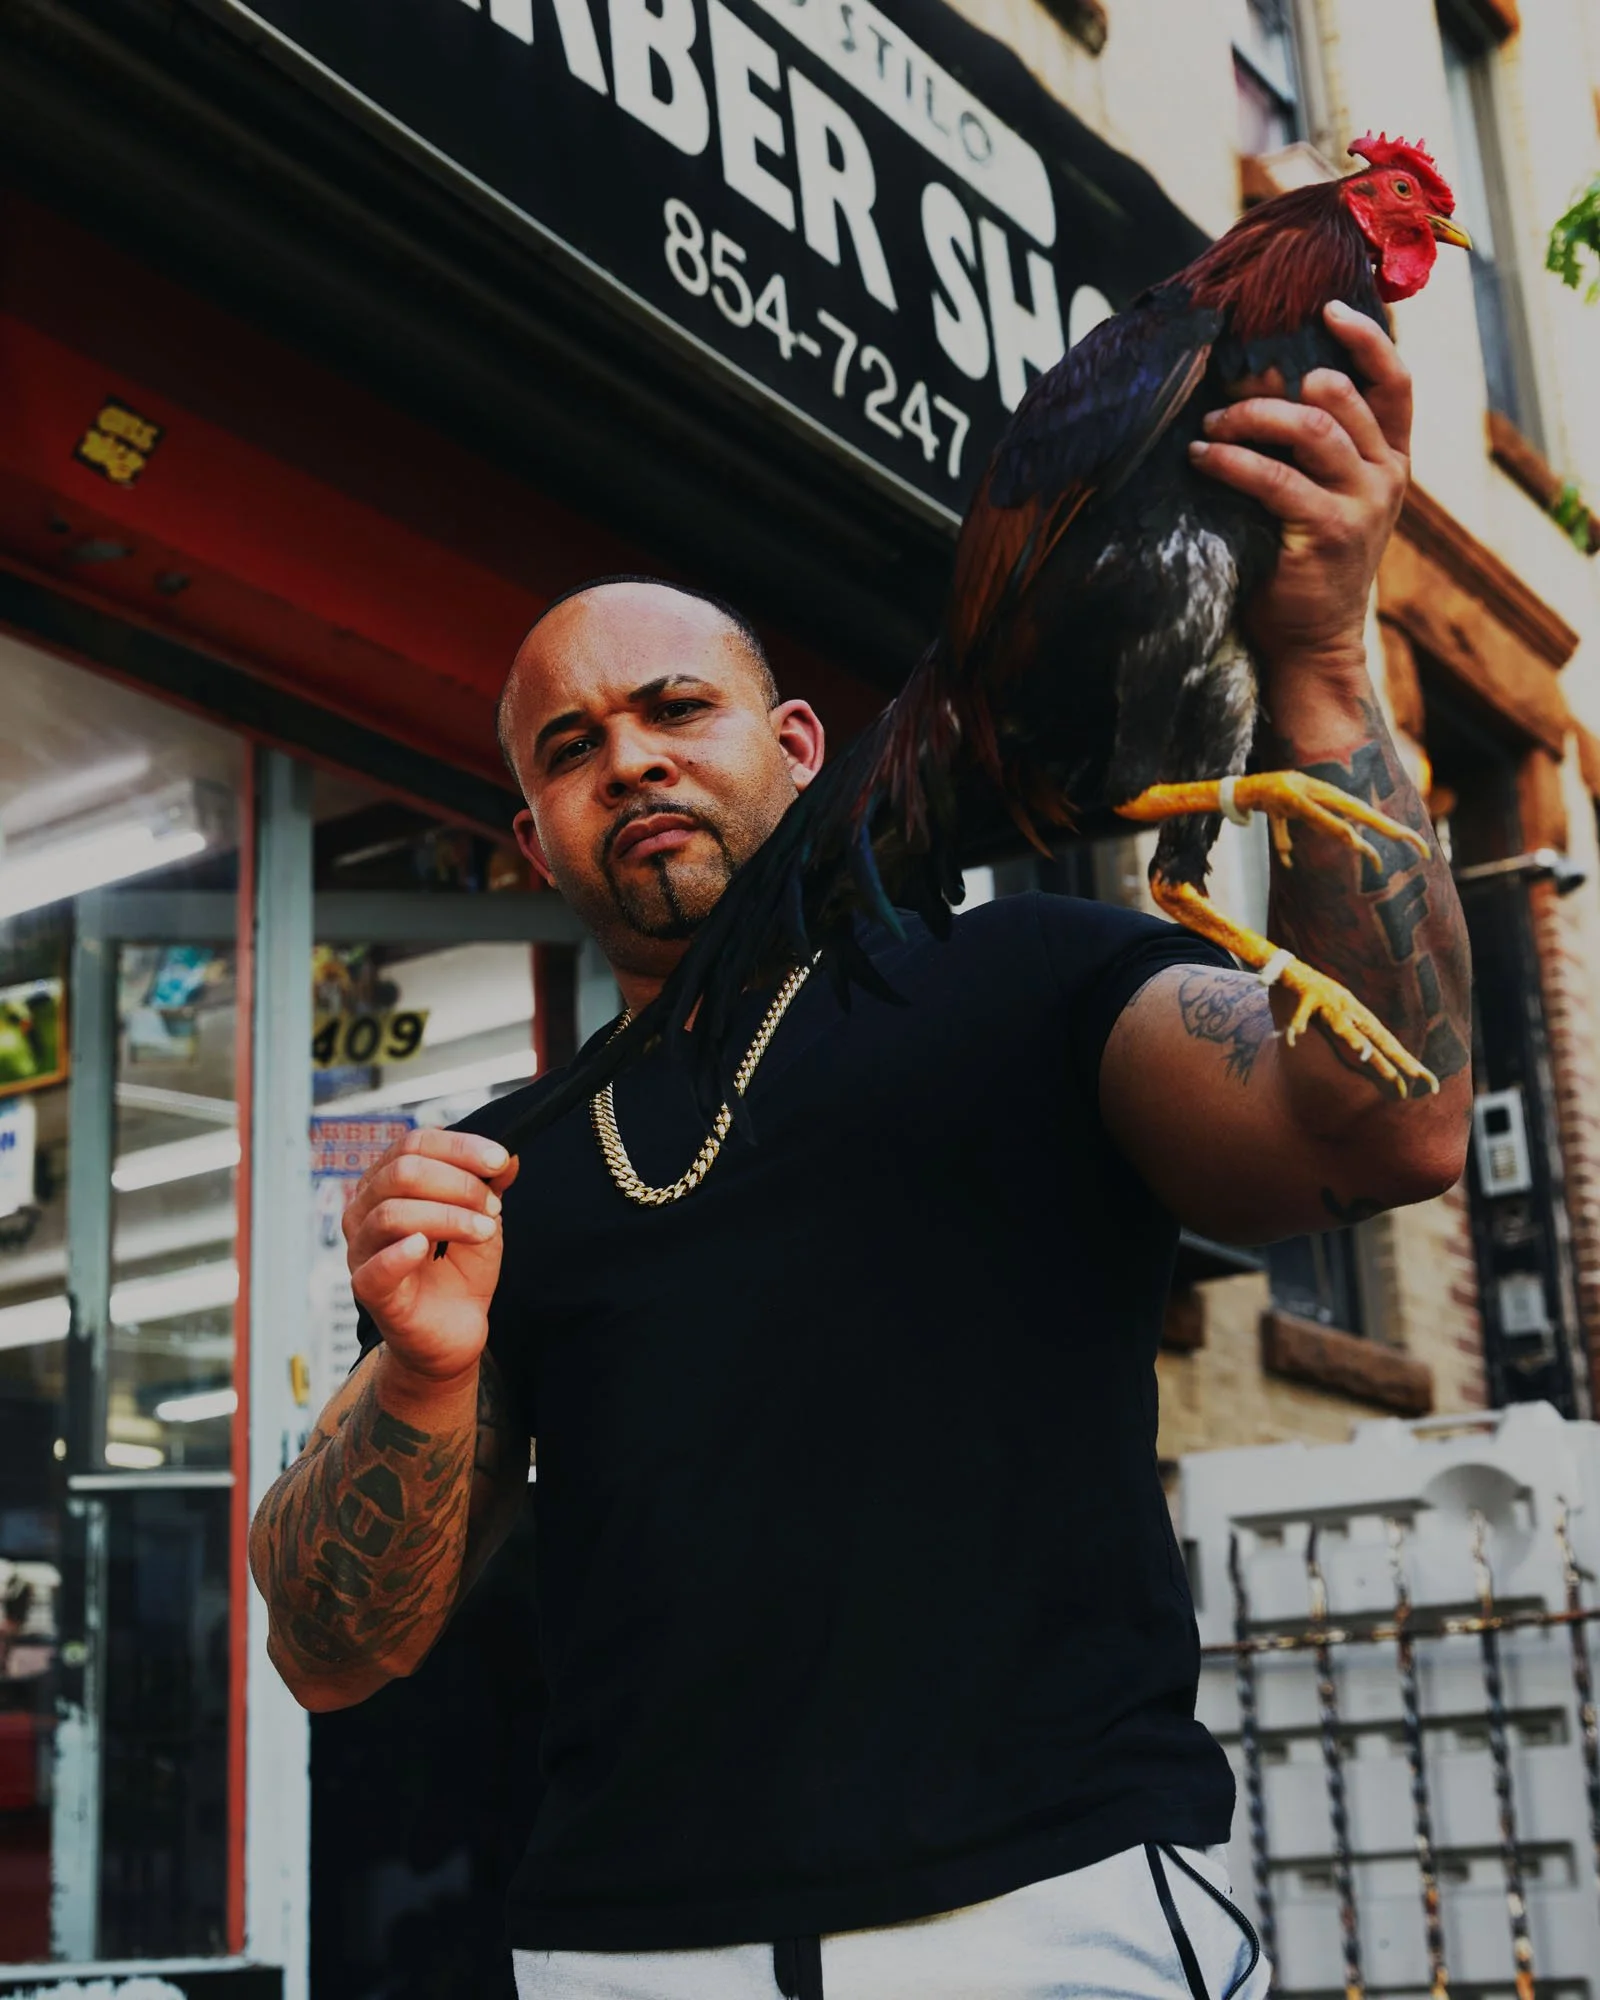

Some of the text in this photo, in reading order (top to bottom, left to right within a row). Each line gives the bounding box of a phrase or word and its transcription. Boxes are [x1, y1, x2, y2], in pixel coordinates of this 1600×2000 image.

[840, 3, 993, 163] STILO
[664, 198, 971, 478] 854-7247
[921, 181, 1113, 414] SH
[312, 1013, 423, 1063] 409
